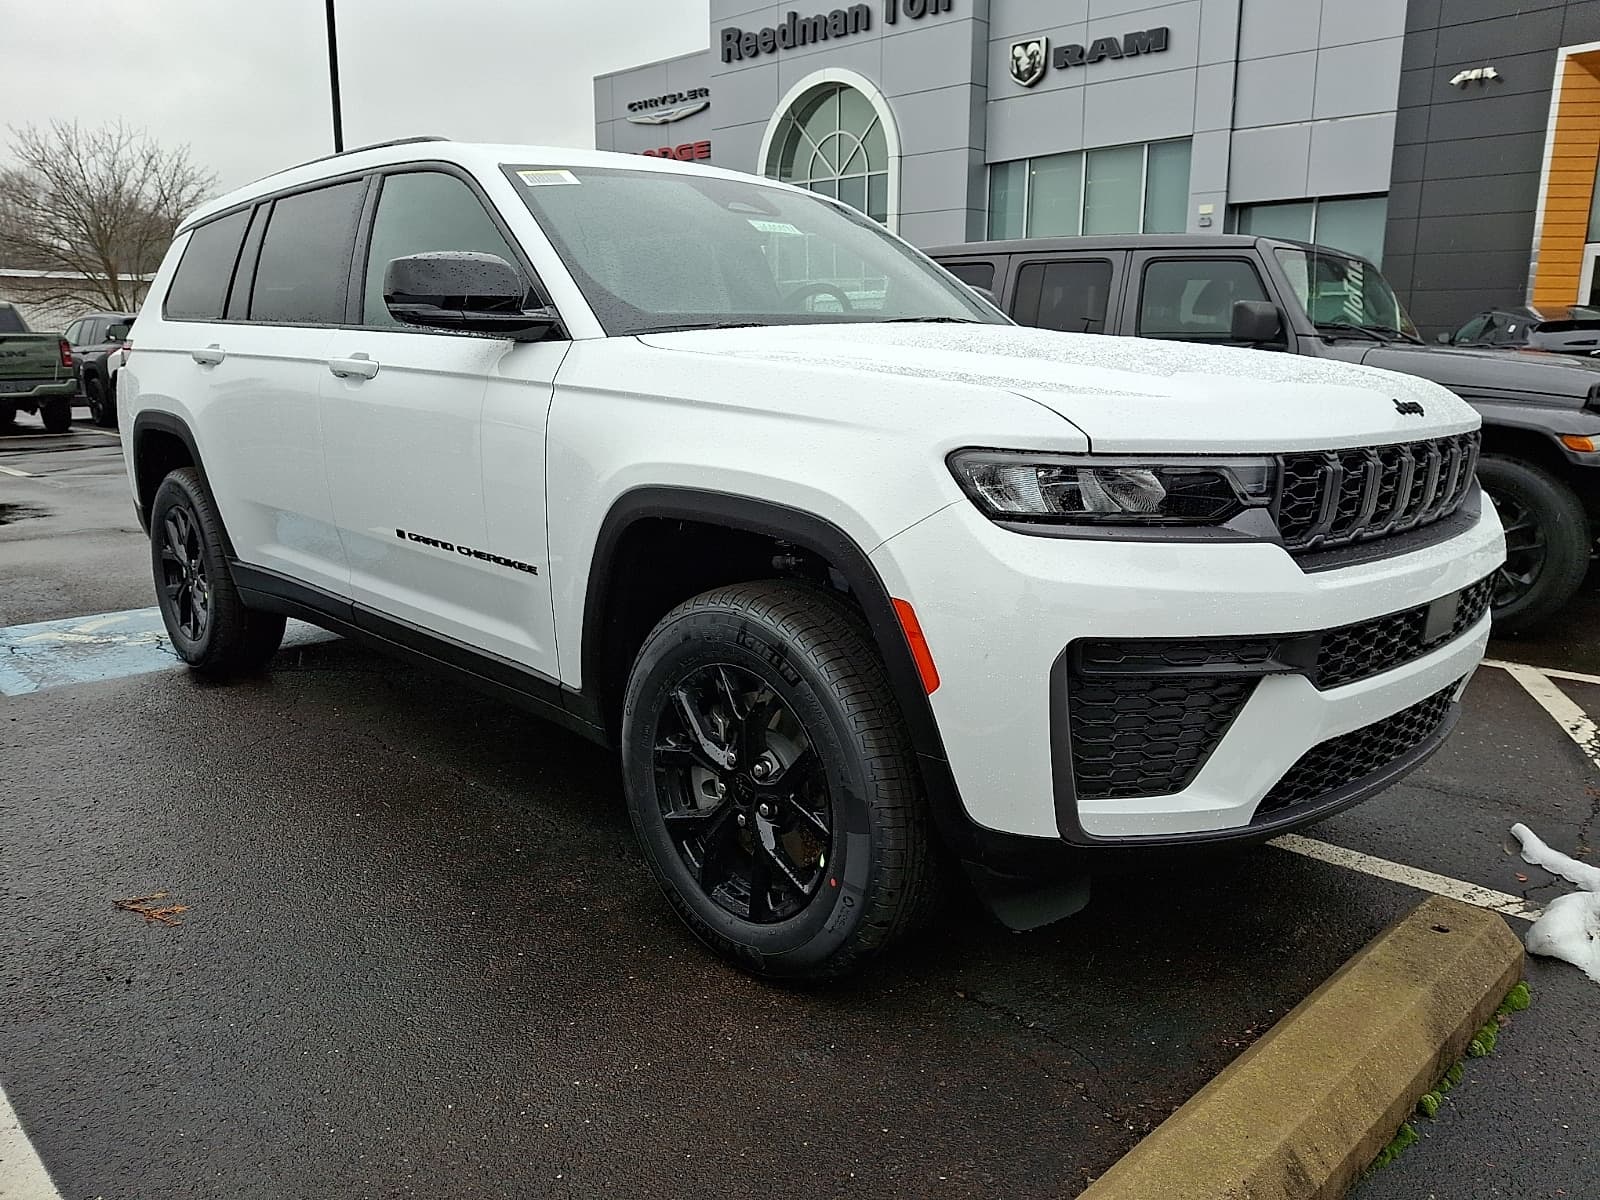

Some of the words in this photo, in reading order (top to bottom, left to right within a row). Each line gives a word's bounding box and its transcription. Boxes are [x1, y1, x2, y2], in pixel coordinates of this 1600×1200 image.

[721, 3, 871, 63] Reedman
[1053, 27, 1169, 69] RAM
[628, 87, 710, 112] CHRYSLER
[407, 532, 455, 552] GRAND
[456, 545, 539, 576] CHEROKEE
